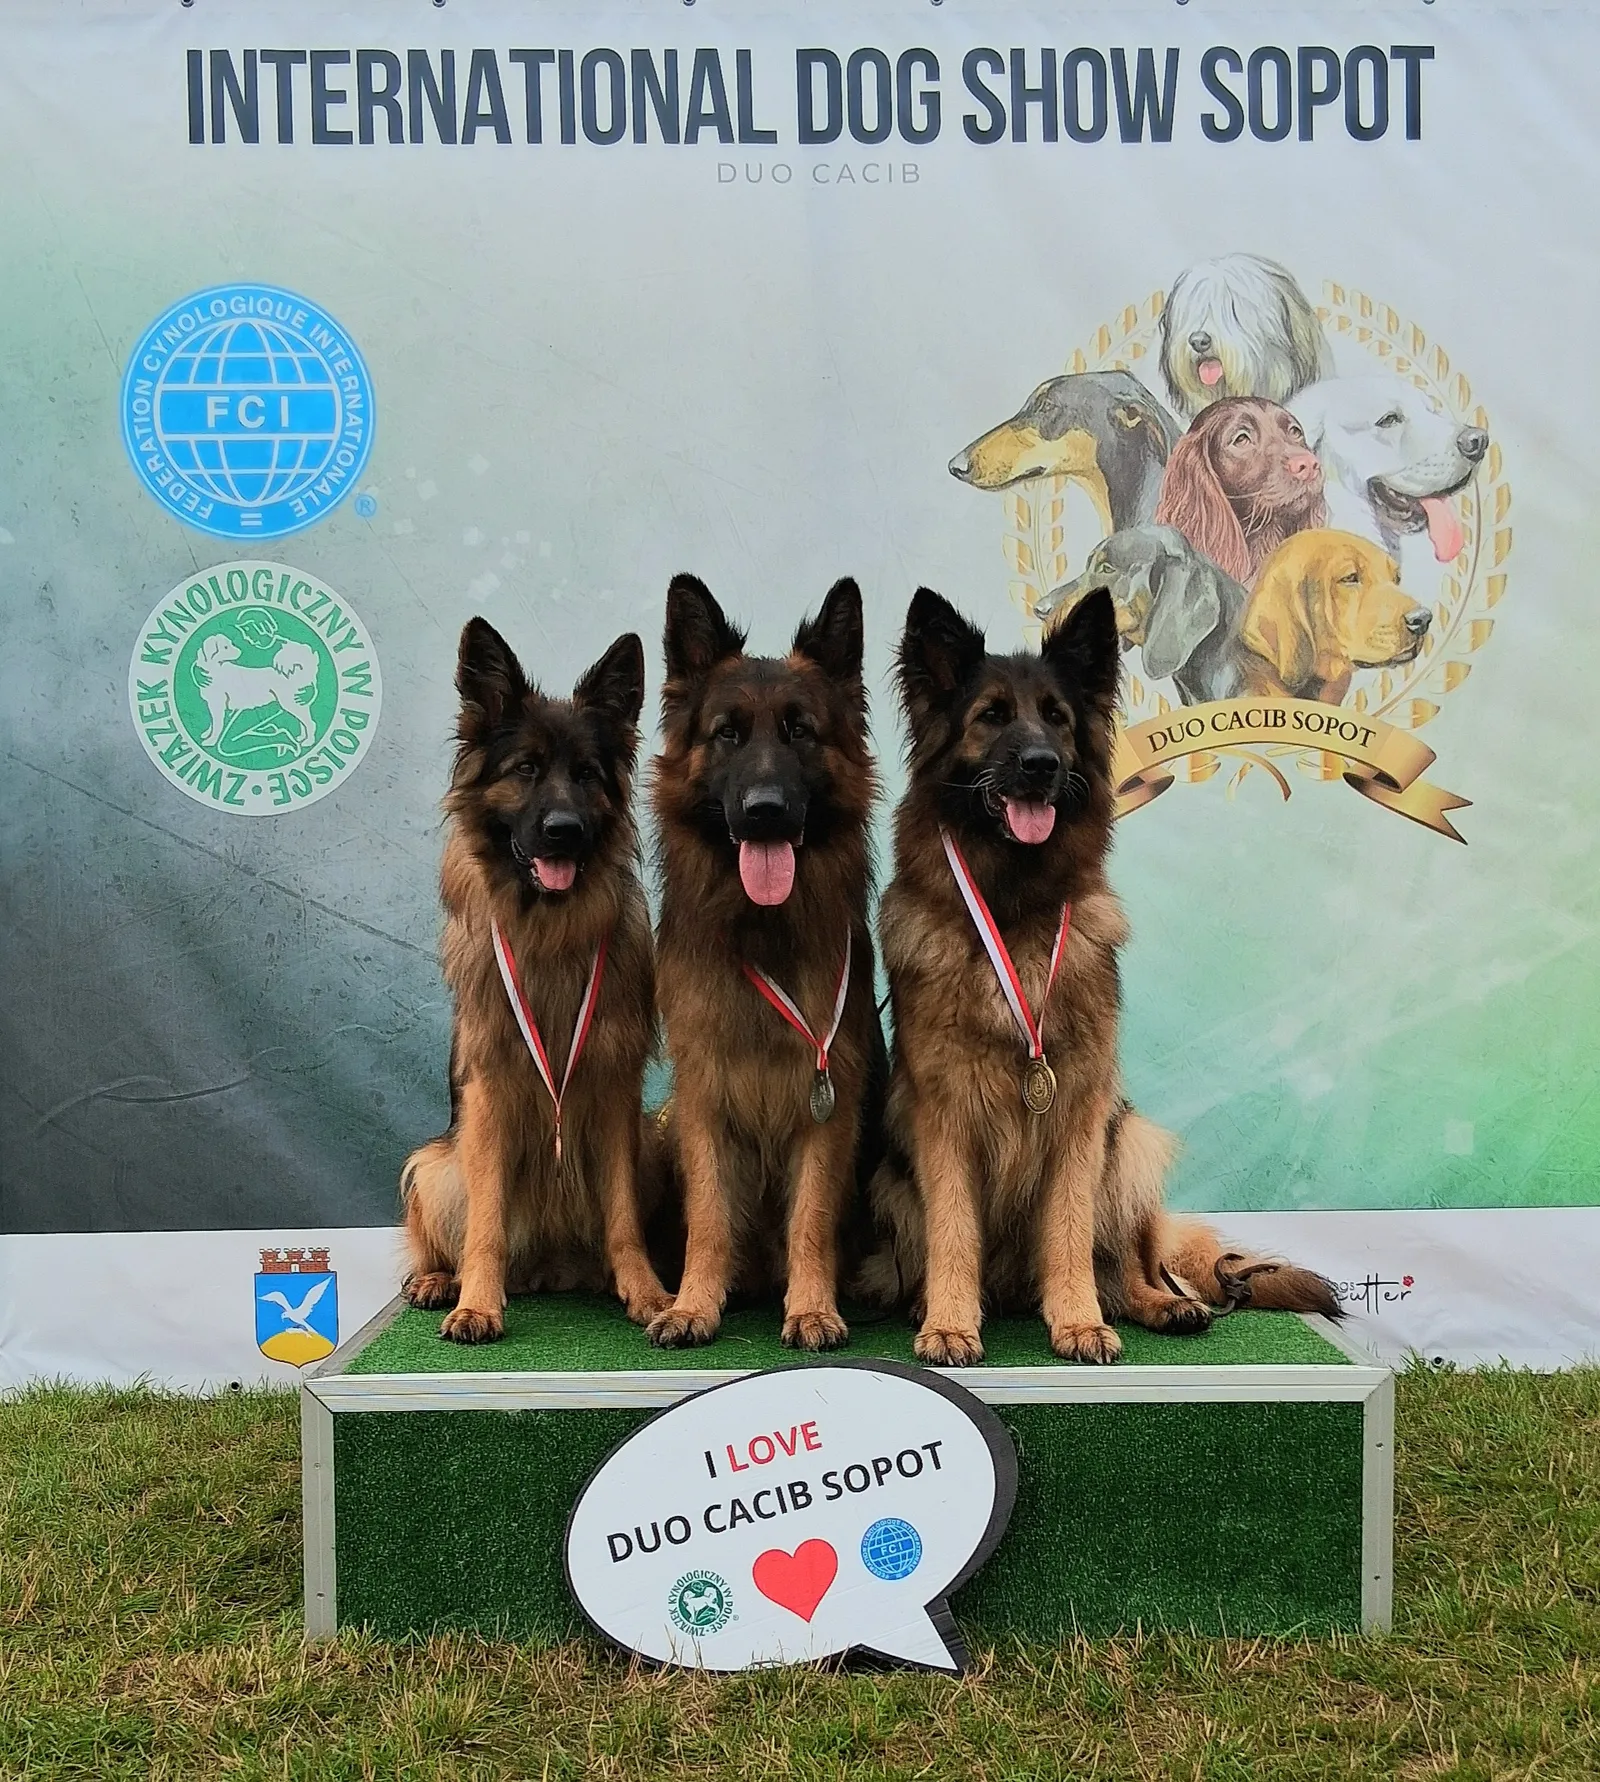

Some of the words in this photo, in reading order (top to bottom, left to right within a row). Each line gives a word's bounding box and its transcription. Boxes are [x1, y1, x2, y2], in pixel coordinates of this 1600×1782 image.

[187, 48, 777, 145] INTERNATIONAL
[796, 48, 941, 145] DOG
[962, 47, 1180, 144] SHOW
[1200, 45, 1435, 143] SOPOT
[717, 162, 794, 184] DUO
[812, 162, 921, 184] CACIB
[143, 295, 309, 372] CYNOLOGIQUE
[206, 395, 289, 428] FCI
[288, 322, 364, 518] INTERNATIONALE
[132, 378, 215, 520] FEDERATION
[140, 569, 365, 665] KYNOLOGICZNY
[341, 660, 374, 697] W
[267, 707, 370, 806] POLSCE
[1146, 717, 1205, 753] DUO
[1211, 708, 1287, 732] CACIB
[1292, 710, 1377, 748] SOPOT
[704, 1450, 717, 1479] I
[726, 1420, 823, 1473] LOVE
[606, 1515, 692, 1563] DUO
[703, 1480, 813, 1534] CACIB
[821, 1440, 944, 1501] SOPOT
[880, 1542, 903, 1556] FCI
[709, 1601, 734, 1633] POLSCE
[722, 1587, 733, 1598] W
